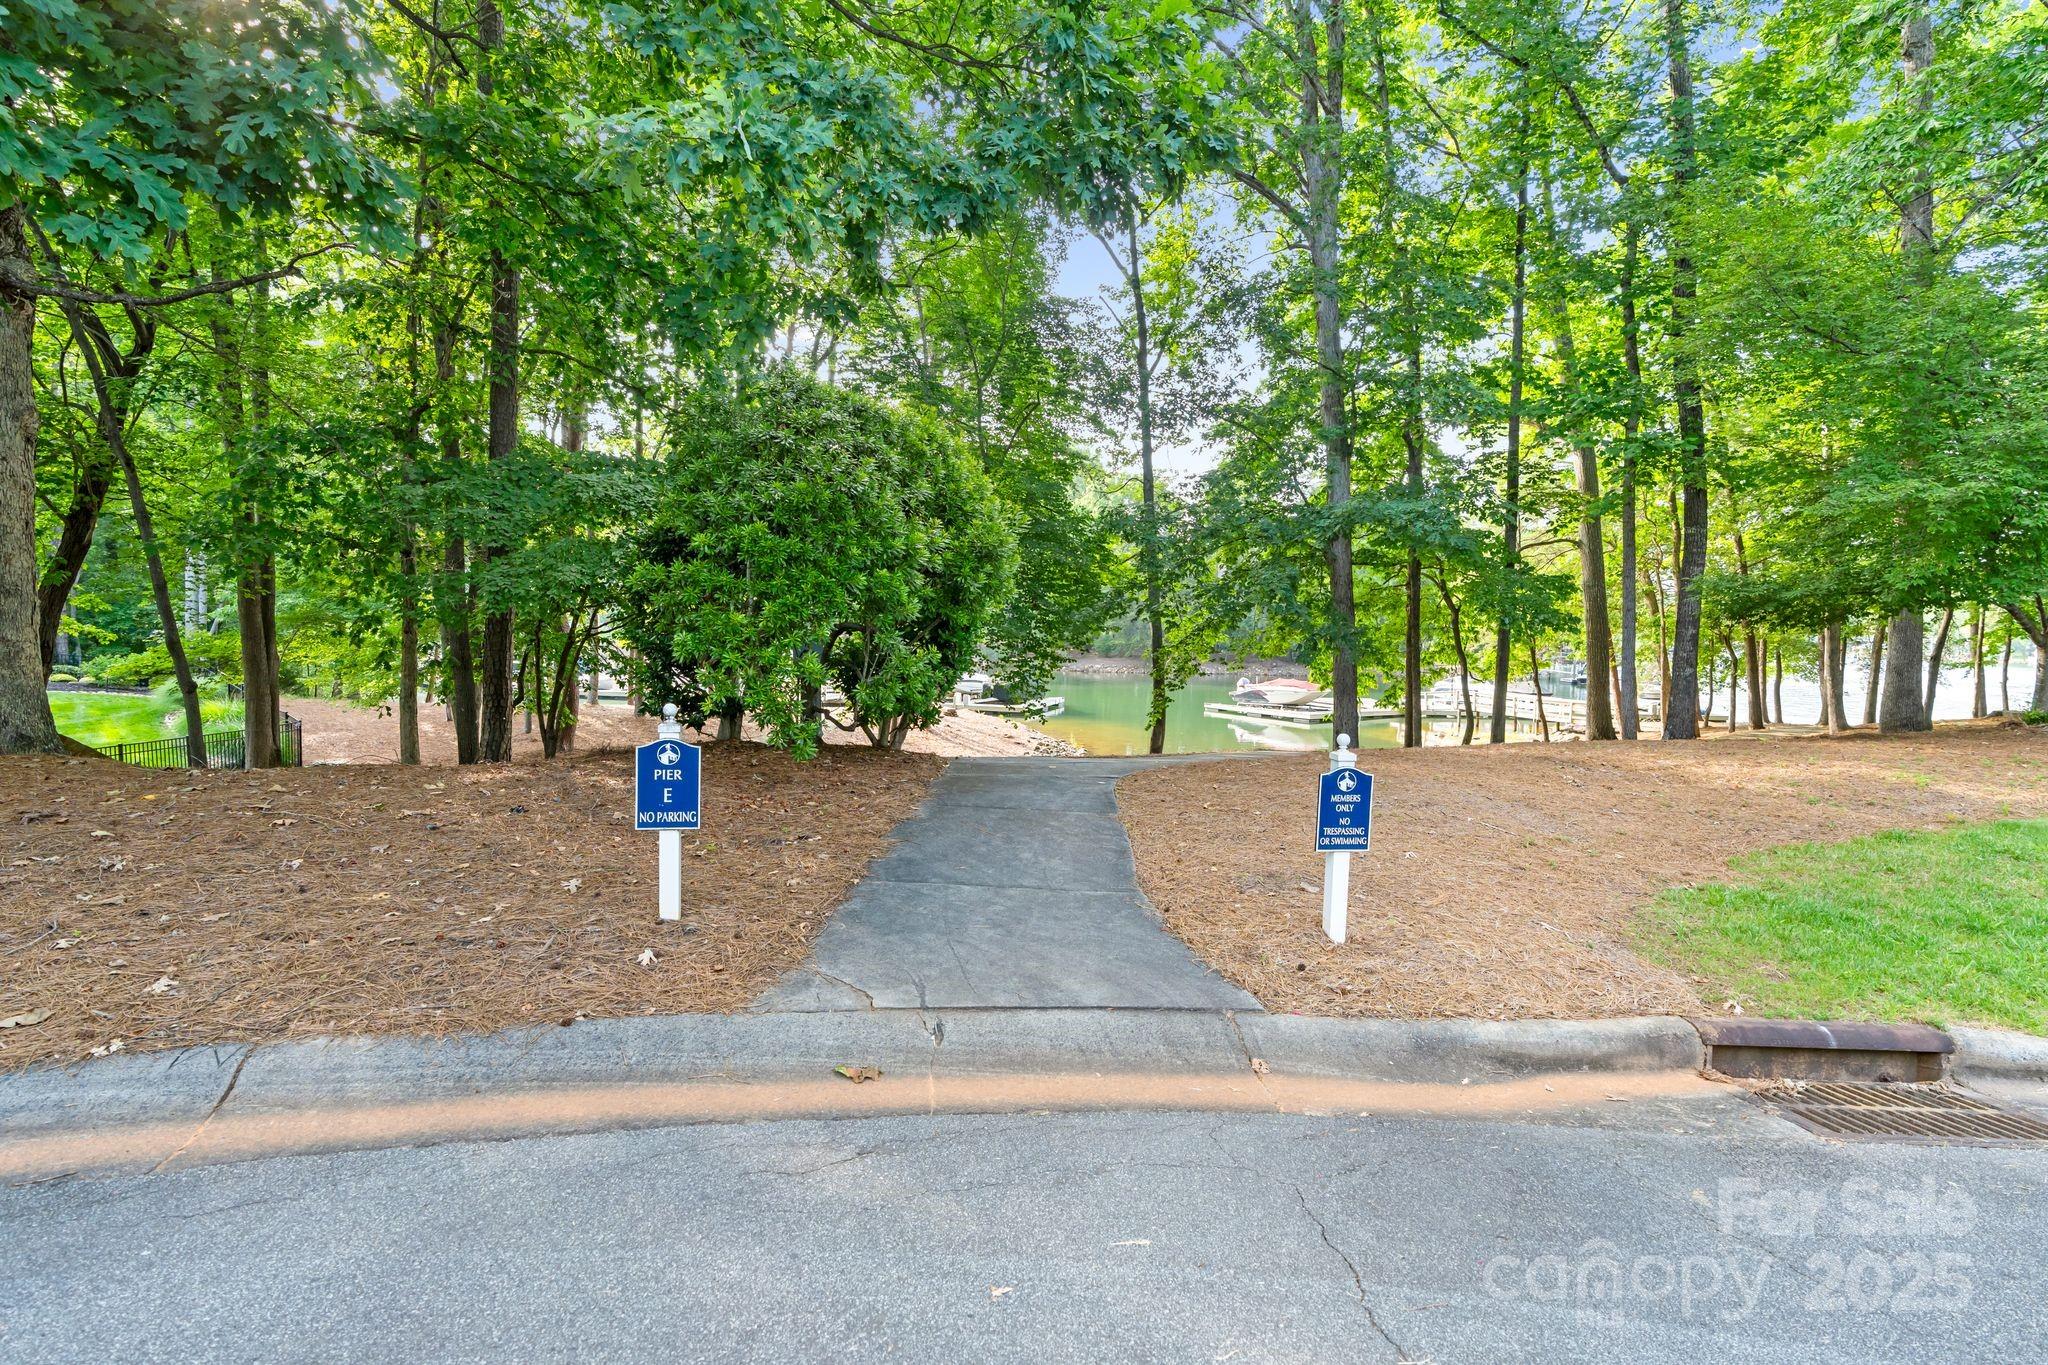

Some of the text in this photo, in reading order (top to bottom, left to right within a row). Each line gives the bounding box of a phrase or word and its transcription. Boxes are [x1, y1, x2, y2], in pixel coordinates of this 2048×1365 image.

[654, 769, 682, 780] PIER
[663, 788, 673, 803] E
[1330, 794, 1361, 803] MEMBERS
[1335, 804, 1354, 812] ONLY
[640, 811, 697, 823] NO PARKING
[1339, 817, 1350, 826] NO
[1323, 827, 1365, 836] TRESPASSING
[1320, 837, 1367, 846] OR SWIMMING
